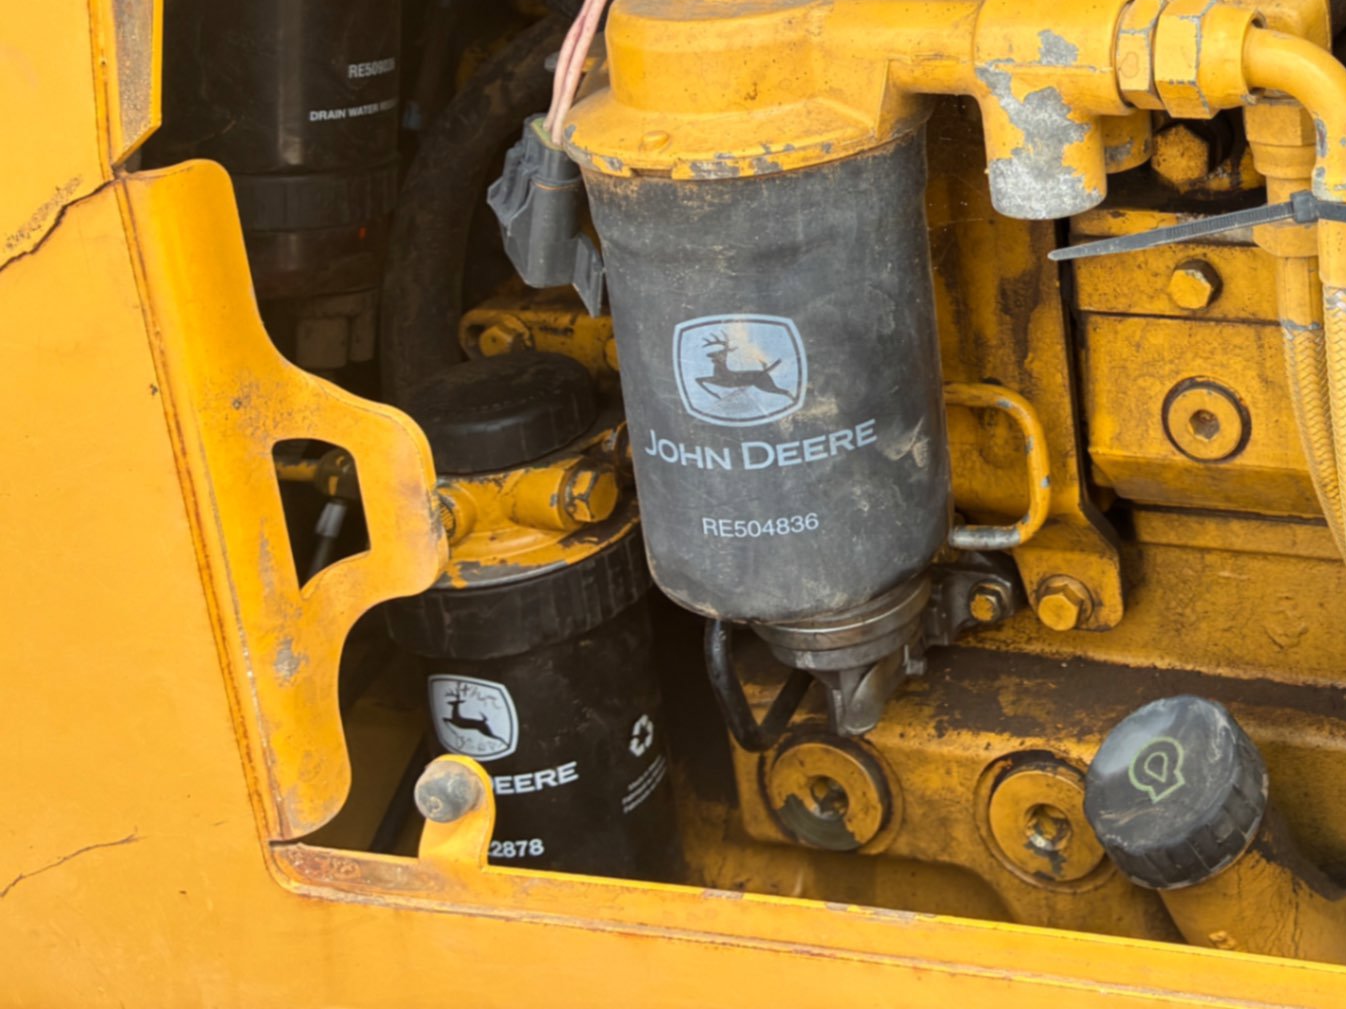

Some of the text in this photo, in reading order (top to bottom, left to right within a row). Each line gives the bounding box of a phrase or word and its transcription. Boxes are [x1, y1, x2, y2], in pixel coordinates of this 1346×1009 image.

[309, 109, 346, 122] DRAIN
[645, 419, 878, 470] JOHN DEERE
[702, 512, 819, 538] RE504836
[491, 761, 579, 795] EERE
[488, 838, 544, 858] 2878
